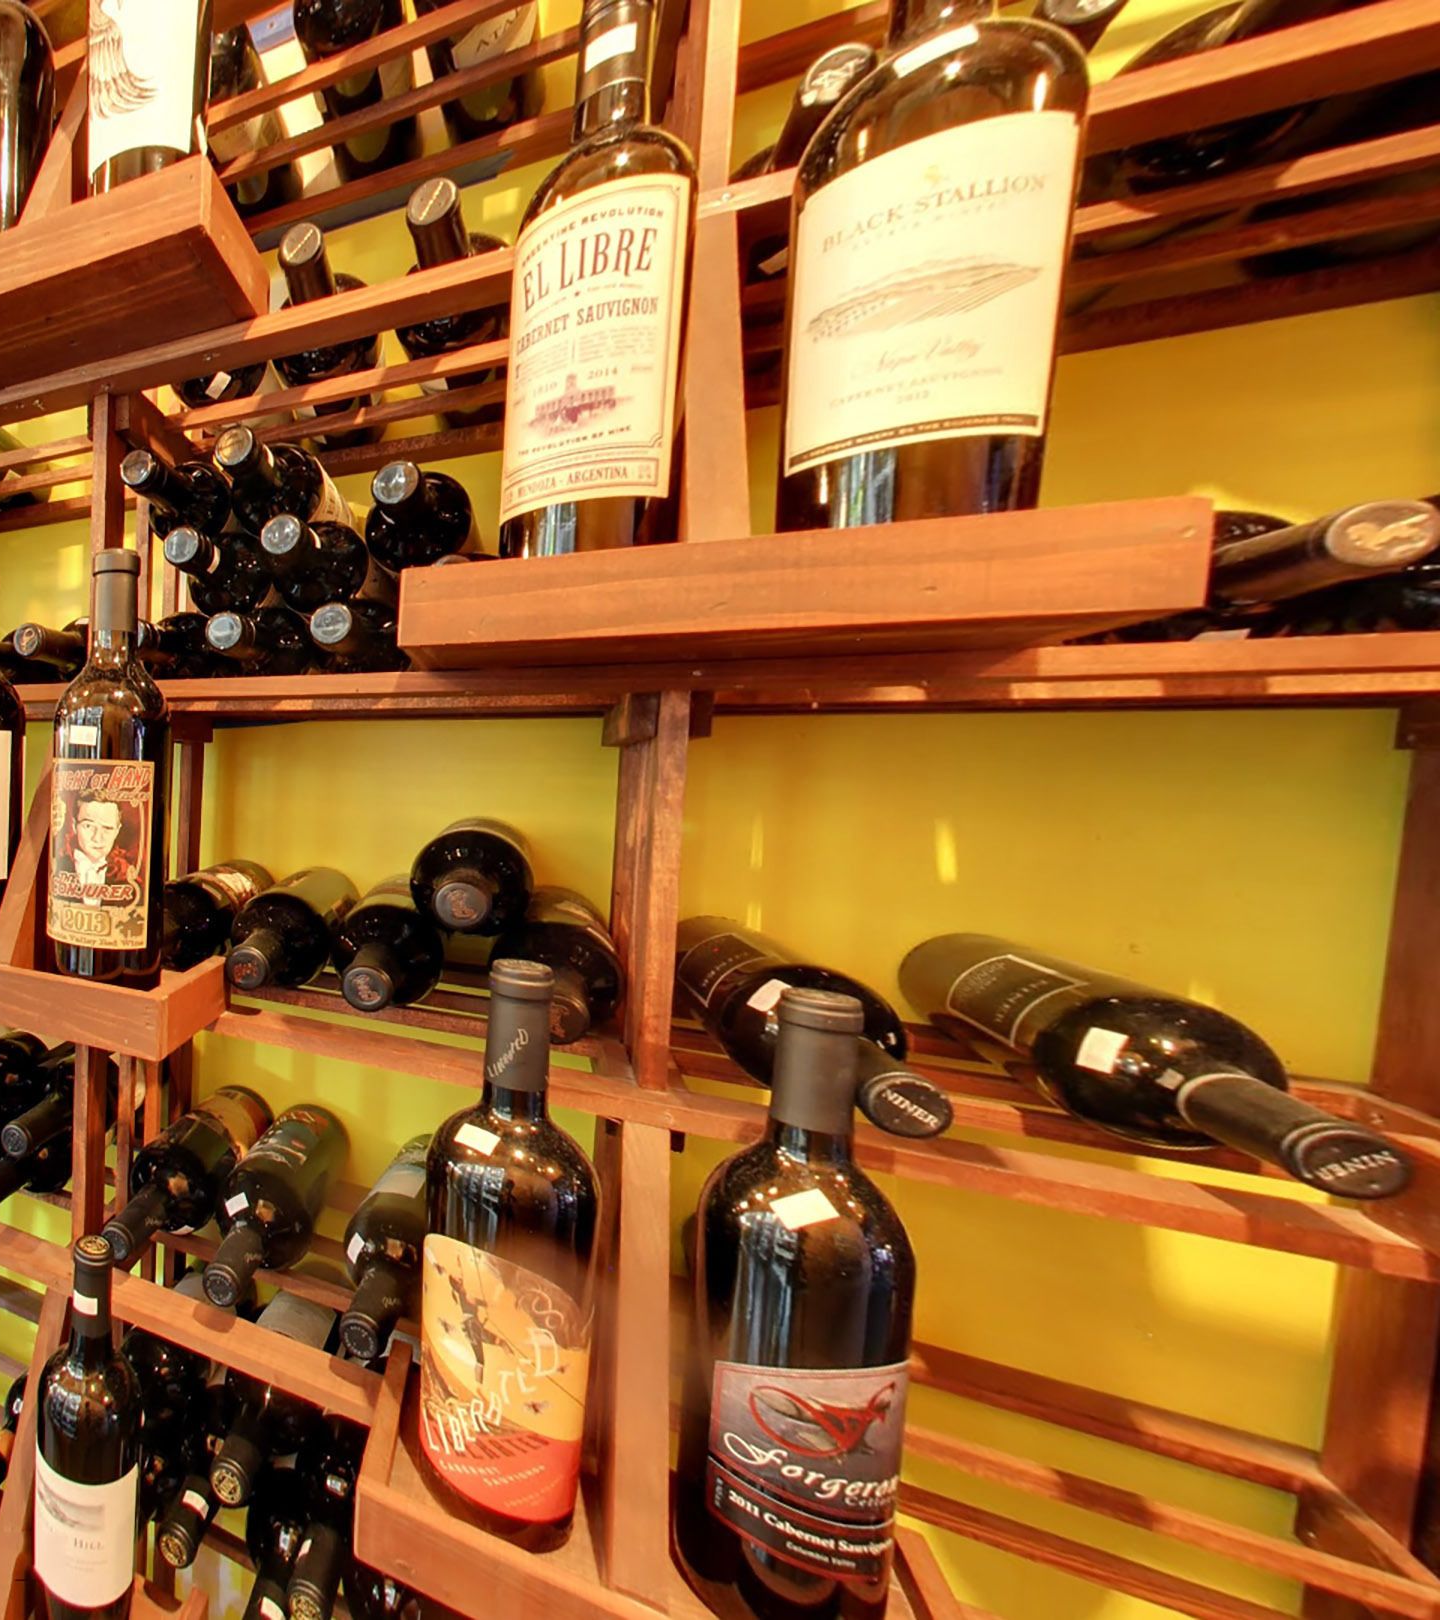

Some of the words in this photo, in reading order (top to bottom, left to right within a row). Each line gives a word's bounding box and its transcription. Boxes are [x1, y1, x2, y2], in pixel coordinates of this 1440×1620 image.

[579, 205, 664, 227] REVOLUTION
[821, 203, 904, 254] BLACK
[912, 173, 1047, 213] STALLION
[522, 260, 550, 314] EL
[559, 226, 658, 291] LIBRE
[516, 313, 571, 357] CABERNET
[575, 296, 659, 327] SAUVIGNON
[517, 476, 557, 498] MENDOZA
[565, 465, 629, 485] ARGENTINA
[107, 765, 152, 793] HAND
[62, 908, 106, 933] 2013
[881, 1087, 940, 1130] NINER
[422, 1326, 561, 1456] LIBERATED
[727, 1489, 761, 1518] 2011
[762, 1510, 836, 1550] Cabernet
